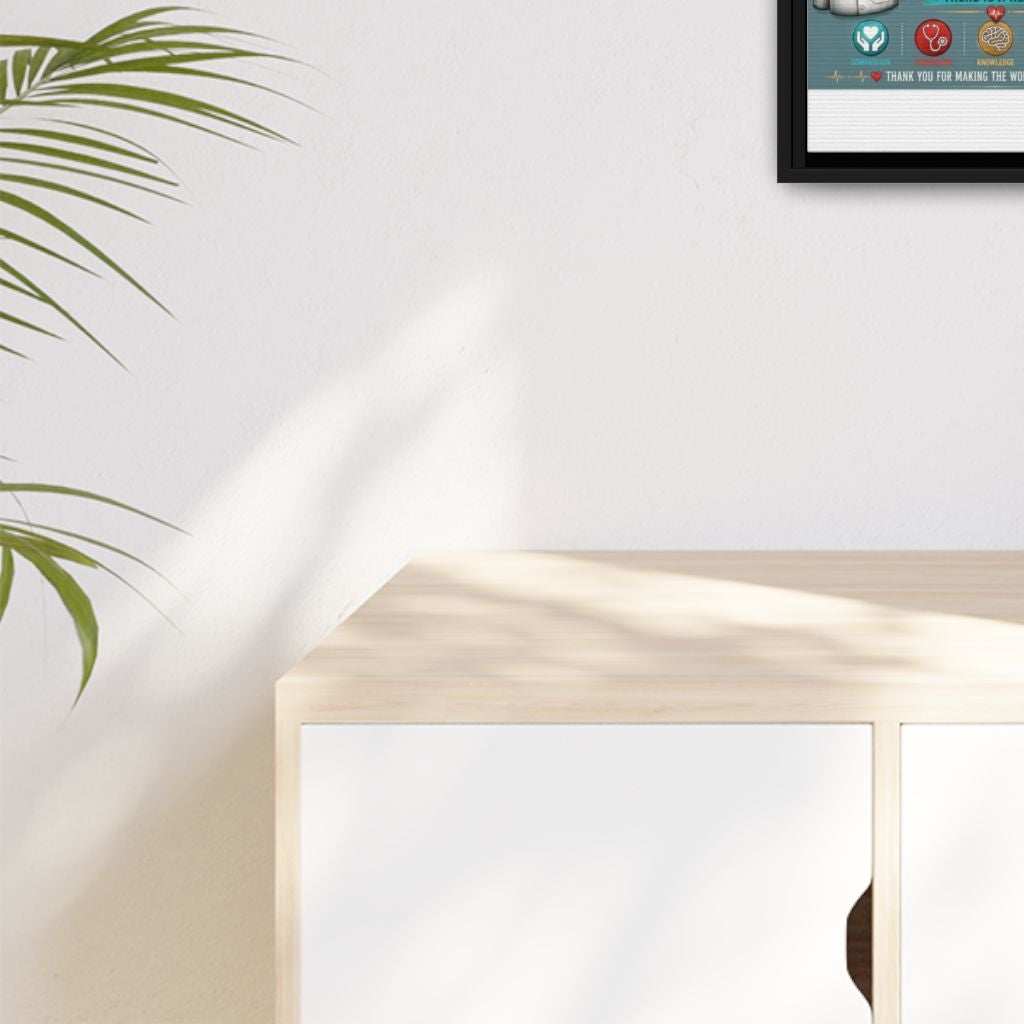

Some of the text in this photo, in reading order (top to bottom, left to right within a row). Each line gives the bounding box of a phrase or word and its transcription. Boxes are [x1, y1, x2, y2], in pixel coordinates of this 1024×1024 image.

[886, 70, 914, 82] THANK
[916, 70, 934, 82] YOU
[937, 70, 952, 82] FOR
[955, 70, 988, 82] MAKING
[991, 70, 1007, 82] THE
